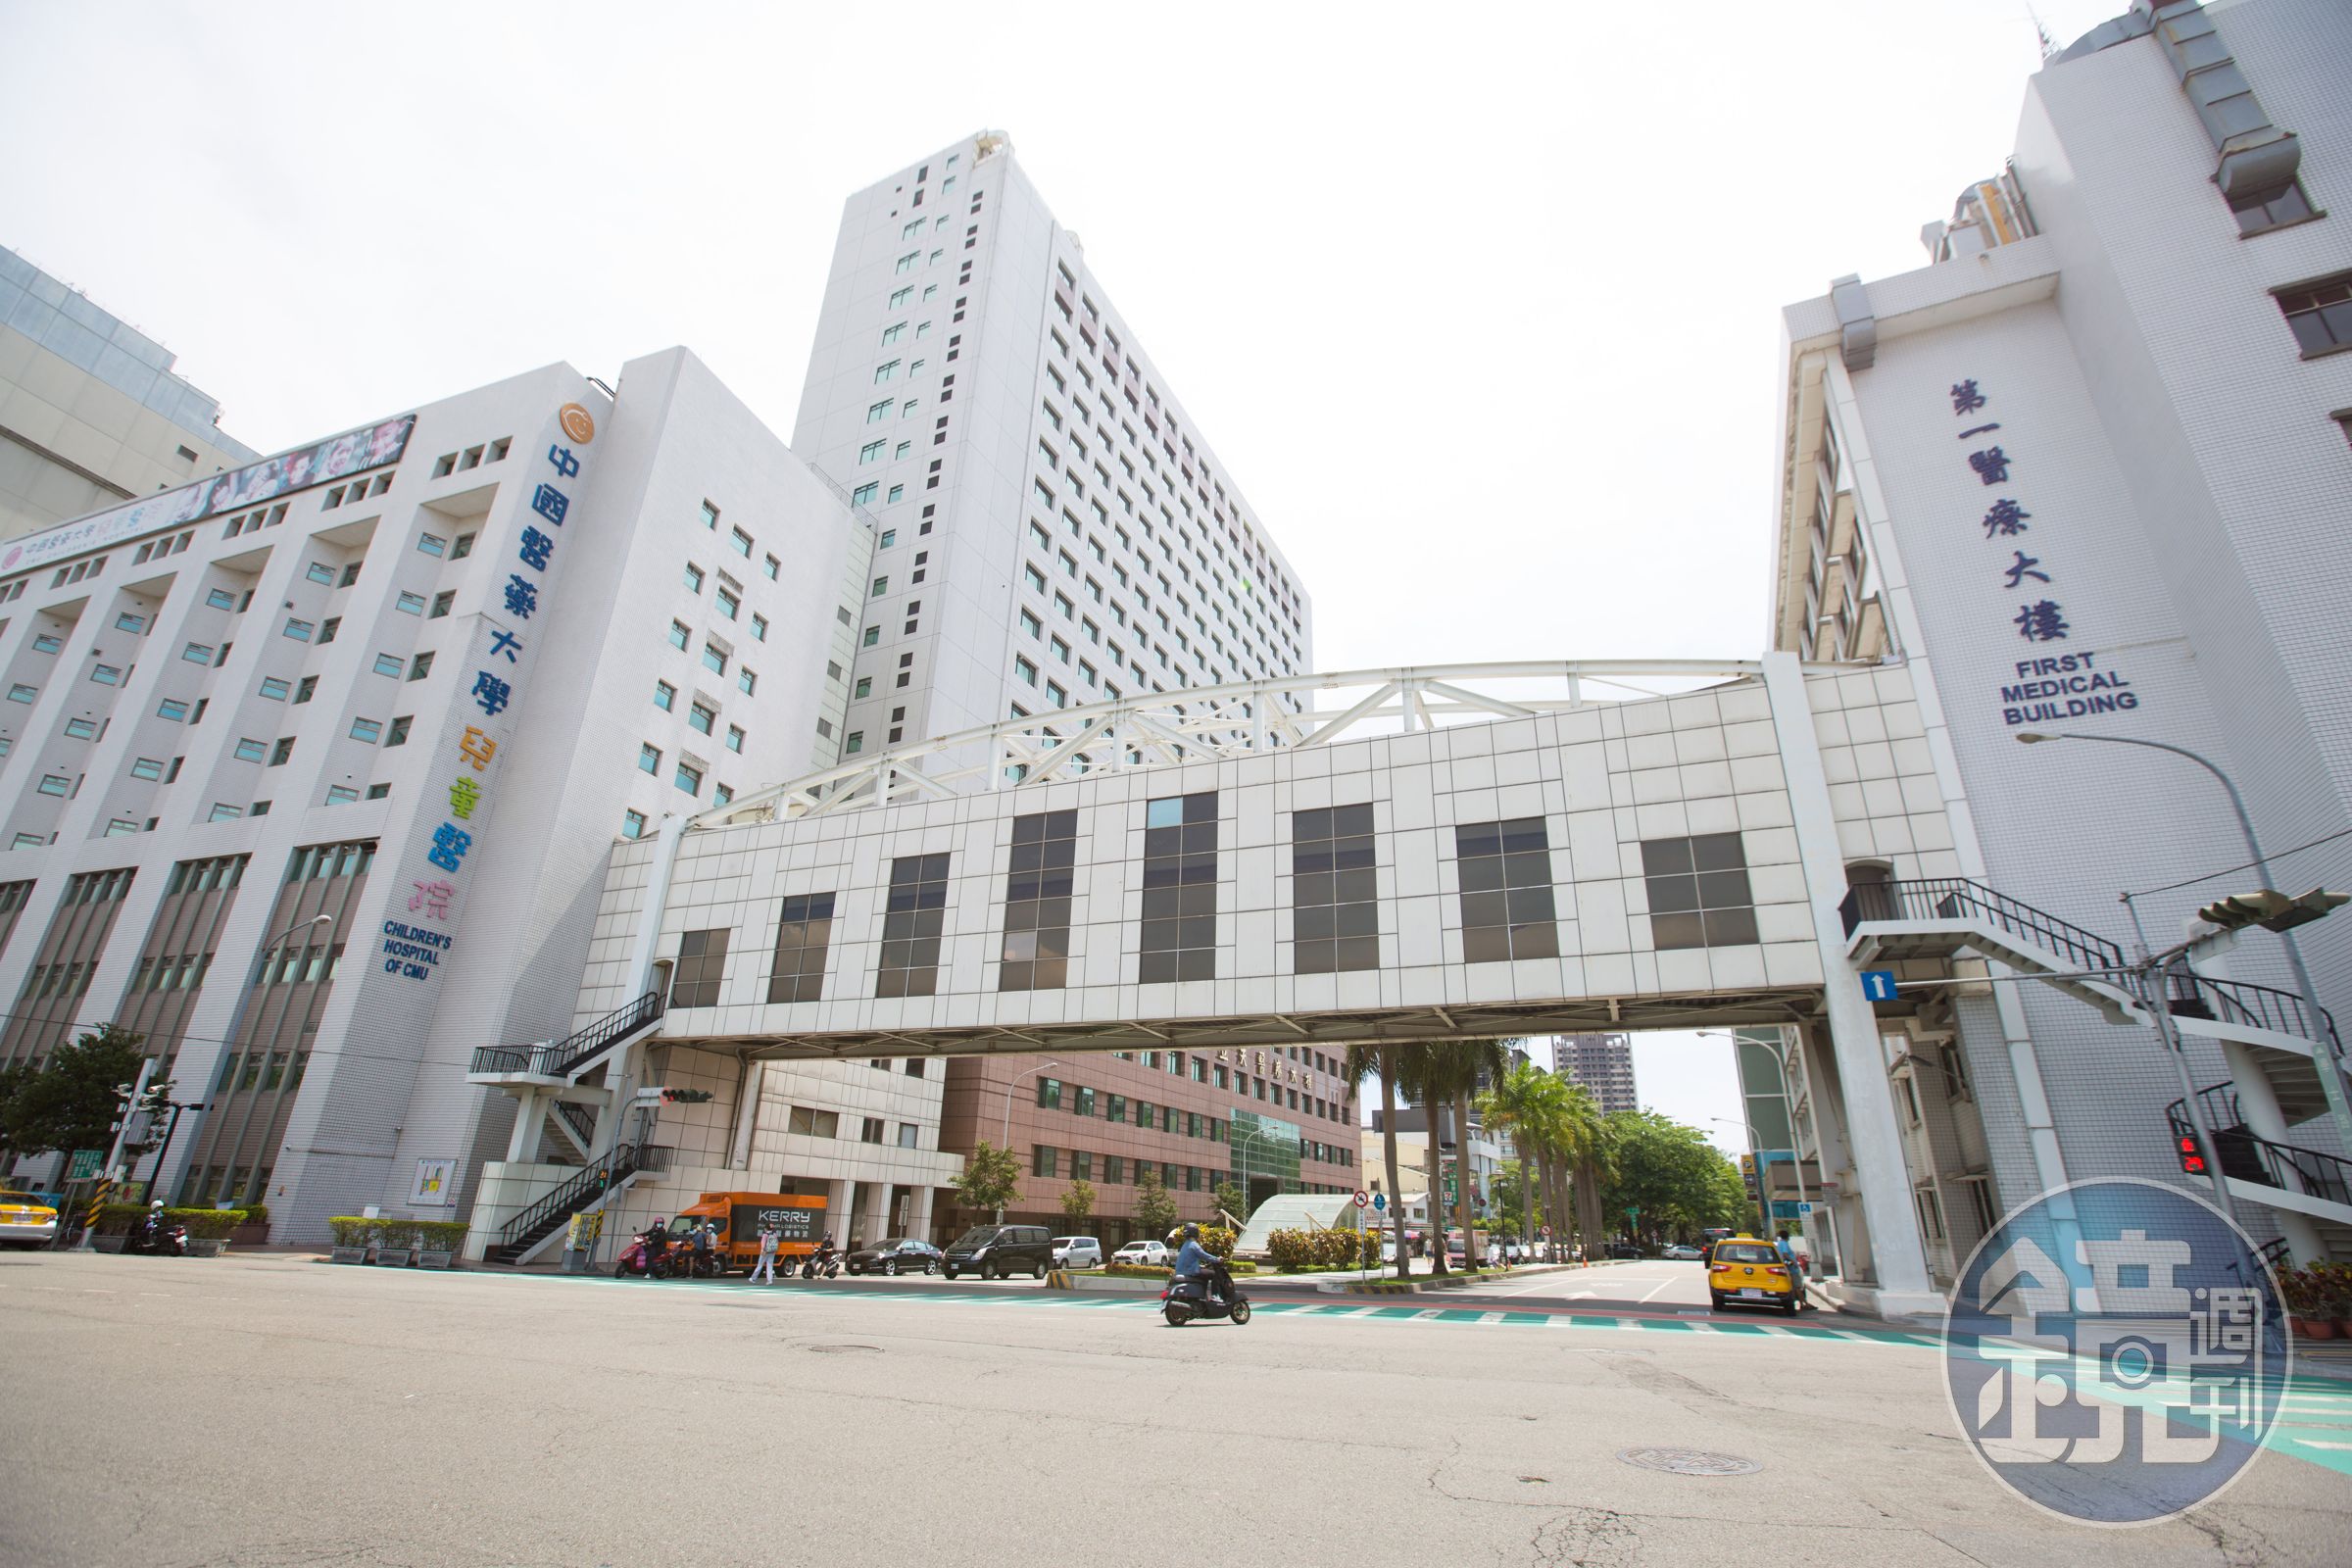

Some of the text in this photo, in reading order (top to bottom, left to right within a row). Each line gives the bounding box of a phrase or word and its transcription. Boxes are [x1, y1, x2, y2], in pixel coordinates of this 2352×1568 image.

[1950, 379, 2070, 642] 第一醫療大樓
[2016, 652, 2094, 679] FIRST
[409, 444, 580, 919] 中國醫藥大學兒童醫院
[2000, 671, 2130, 703] MEDICAL
[2003, 692, 2138, 725] BUILDING
[384, 920, 453, 950] CHILDREN'S
[383, 939, 439, 965] HOSPITAL
[385, 958, 428, 980] OF CMU
[758, 1210, 810, 1223] KERRY
